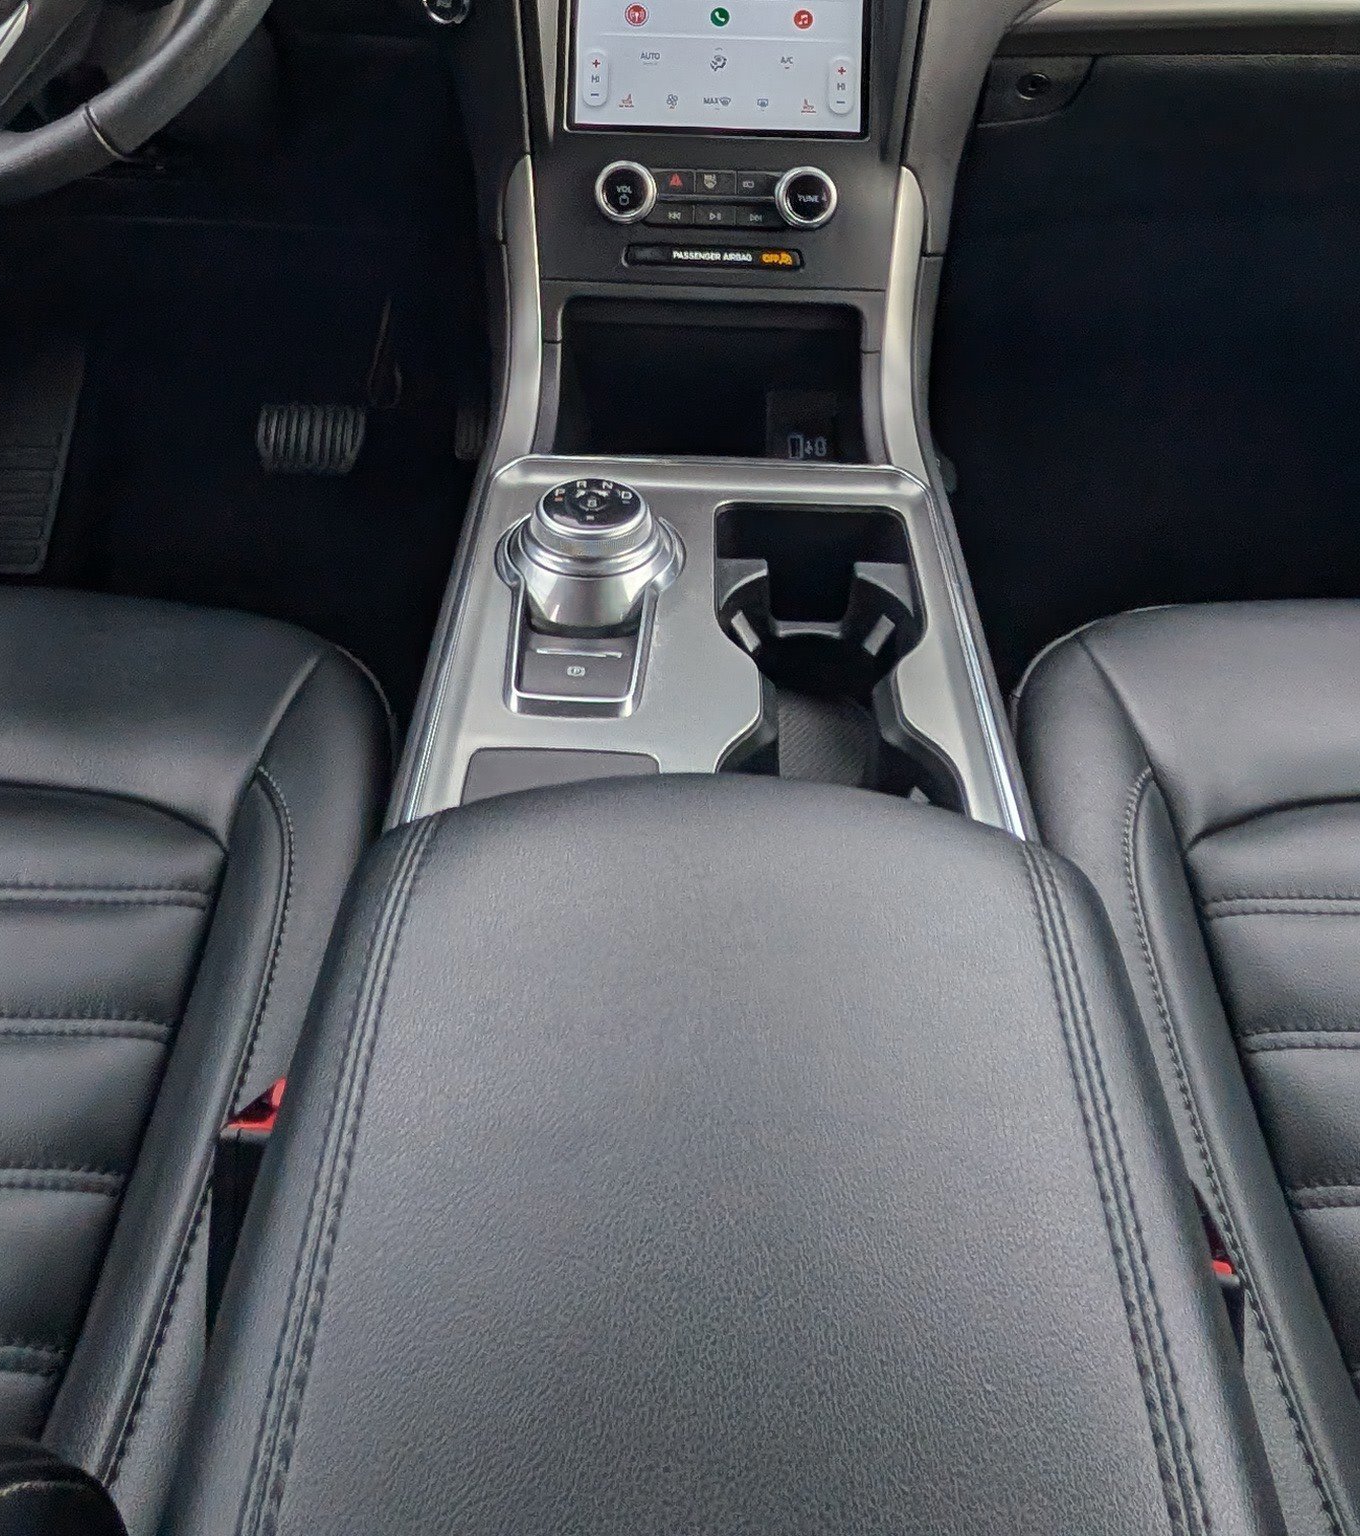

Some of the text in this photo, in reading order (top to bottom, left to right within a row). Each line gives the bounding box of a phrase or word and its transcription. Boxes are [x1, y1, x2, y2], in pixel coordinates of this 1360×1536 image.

[639, 52, 661, 61] AUTO
[672, 250, 721, 261] PASSENGER
[722, 252, 753, 263] AIRBAG
[602, 481, 614, 490] N
[621, 490, 633, 500] D
